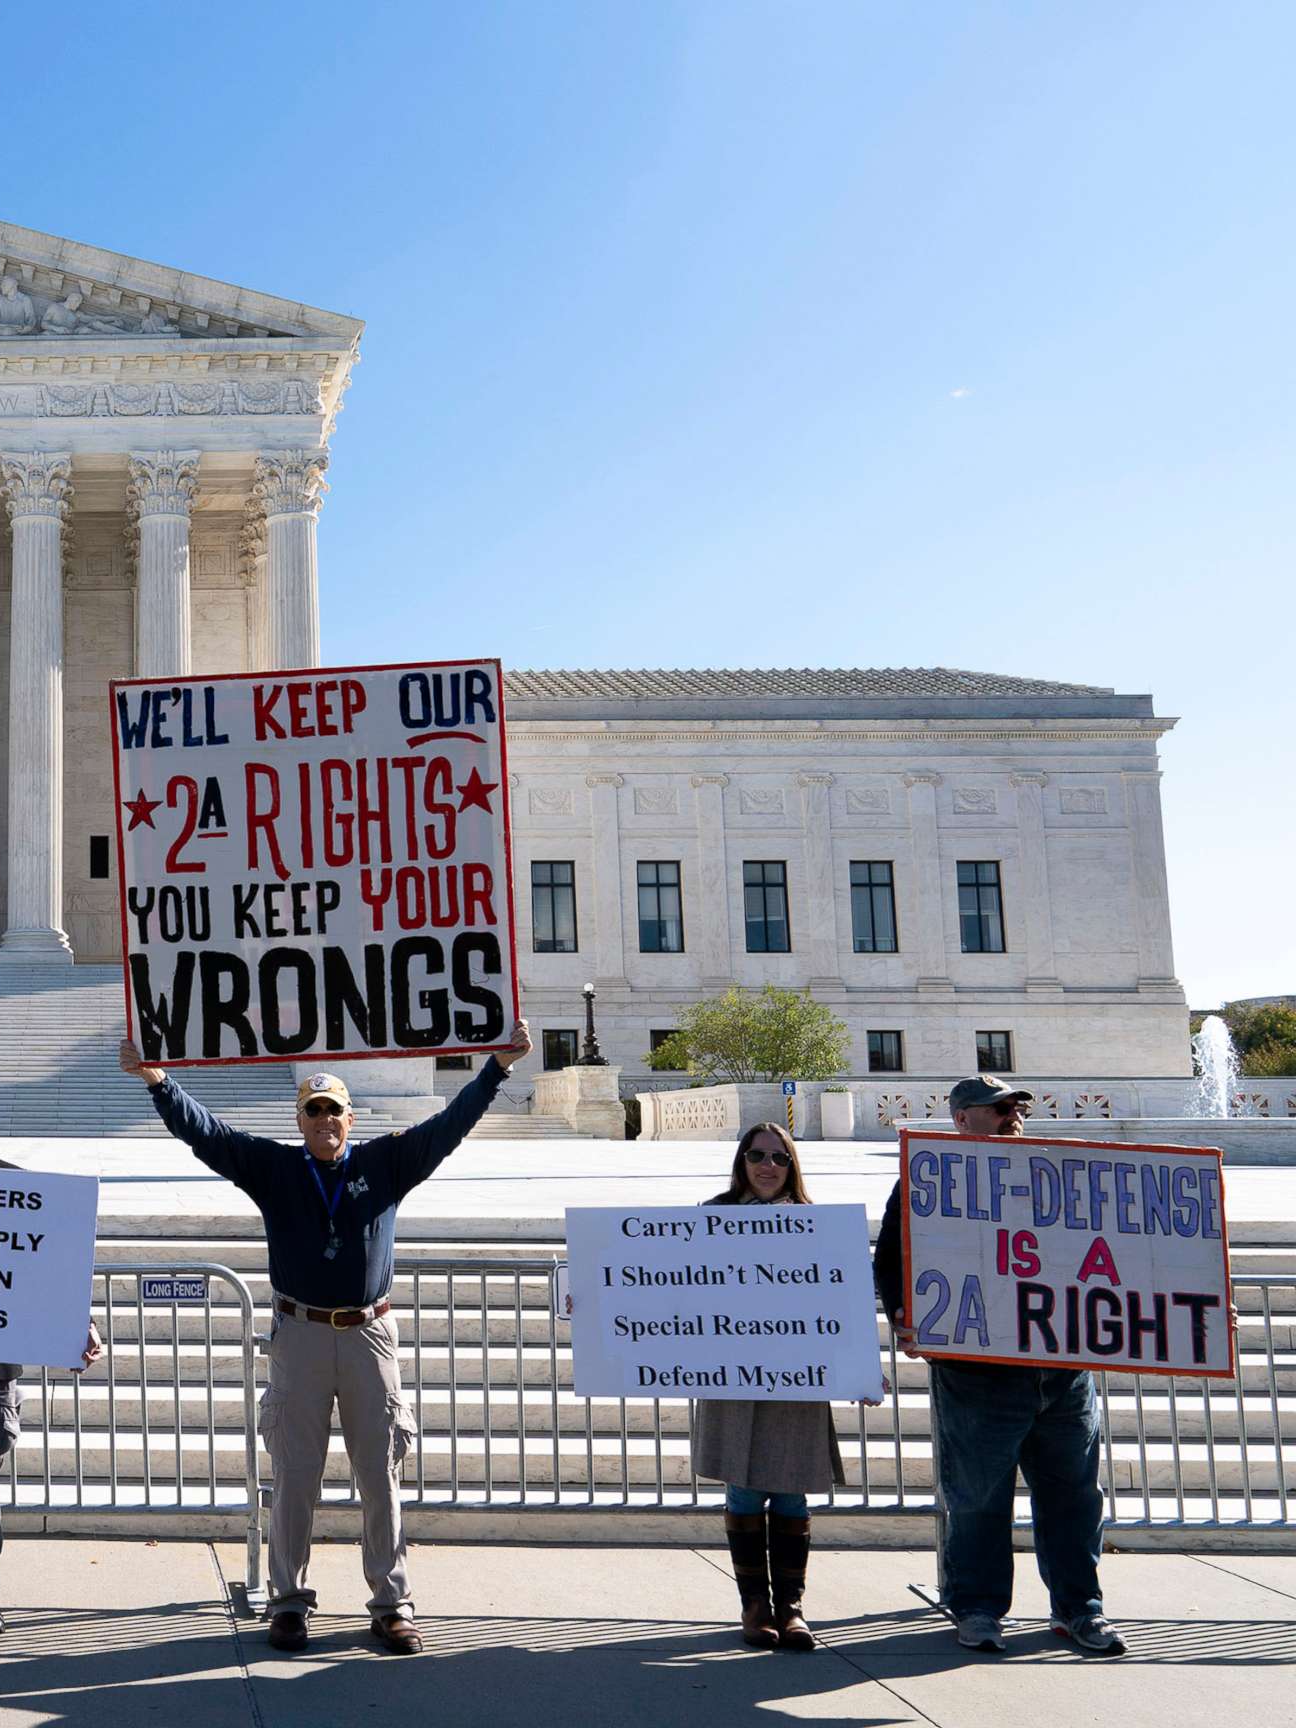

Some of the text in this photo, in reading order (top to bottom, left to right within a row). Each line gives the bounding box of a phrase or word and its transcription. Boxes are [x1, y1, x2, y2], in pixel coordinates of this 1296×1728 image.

[116, 669, 496, 750] WE'LL KEEP OUR
[165, 756, 456, 881] 2A RIGHTS
[128, 863, 497, 944] YOU KEEP YOUR
[129, 931, 504, 1062] WRONGS
[621, 1213, 815, 1242] Carry Permits:
[910, 1150, 1221, 1240] SELF-DEFENSE
[602, 1263, 844, 1287] I Shouldn't Need a
[996, 1228, 1121, 1286] IS A
[614, 1315, 841, 1342] Special Reason to
[915, 1269, 1220, 1365] 2A RIGHT
[637, 1364, 827, 1392] Defend Myself
